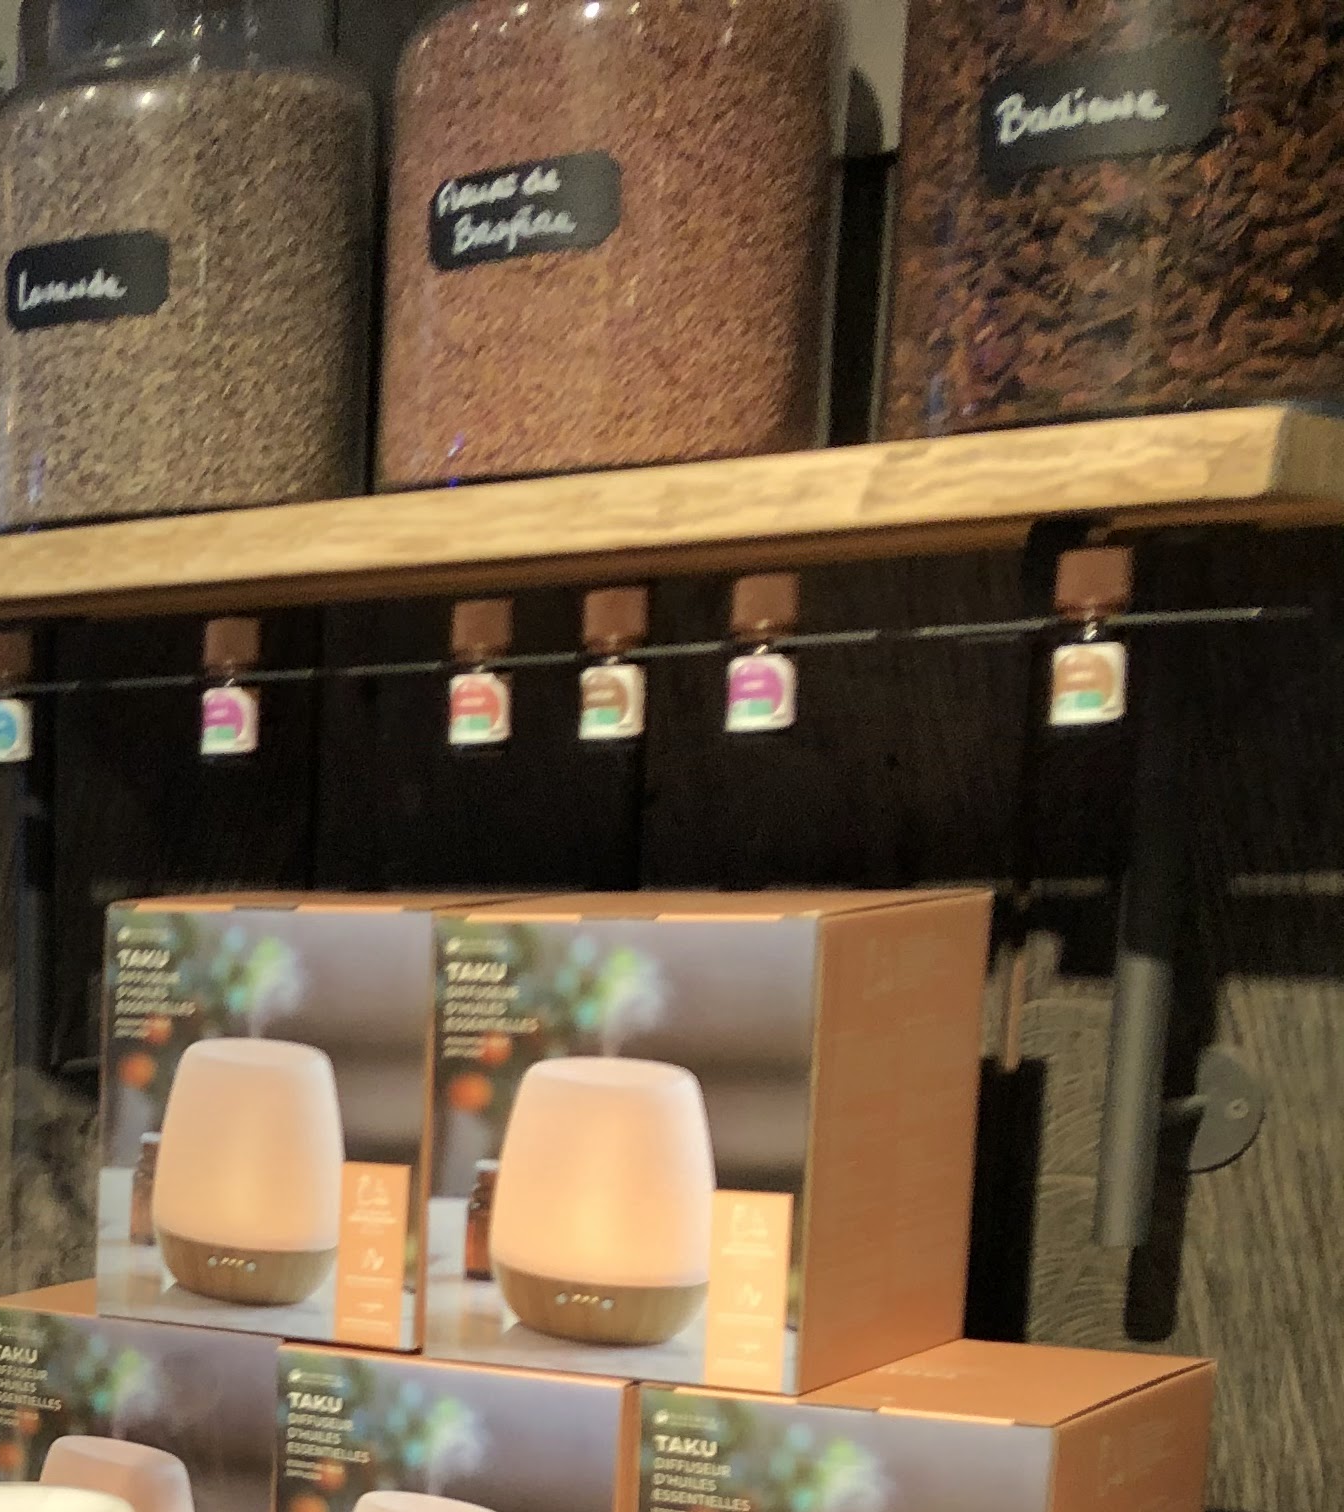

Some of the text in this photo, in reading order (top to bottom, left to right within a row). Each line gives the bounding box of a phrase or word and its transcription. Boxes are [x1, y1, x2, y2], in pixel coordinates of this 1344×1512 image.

[117, 948, 170, 968] TAKU
[445, 961, 508, 982] TAKU
[288, 1391, 344, 1414] TAKU
[286, 1441, 371, 1464] ESSENTIELLES
[653, 1435, 719, 1457] TAKU
[653, 1456, 732, 1478] DIFFUSEUR
[652, 1473, 717, 1493] D'HUILES
[651, 1488, 751, 1512] ESSENTIELLES
